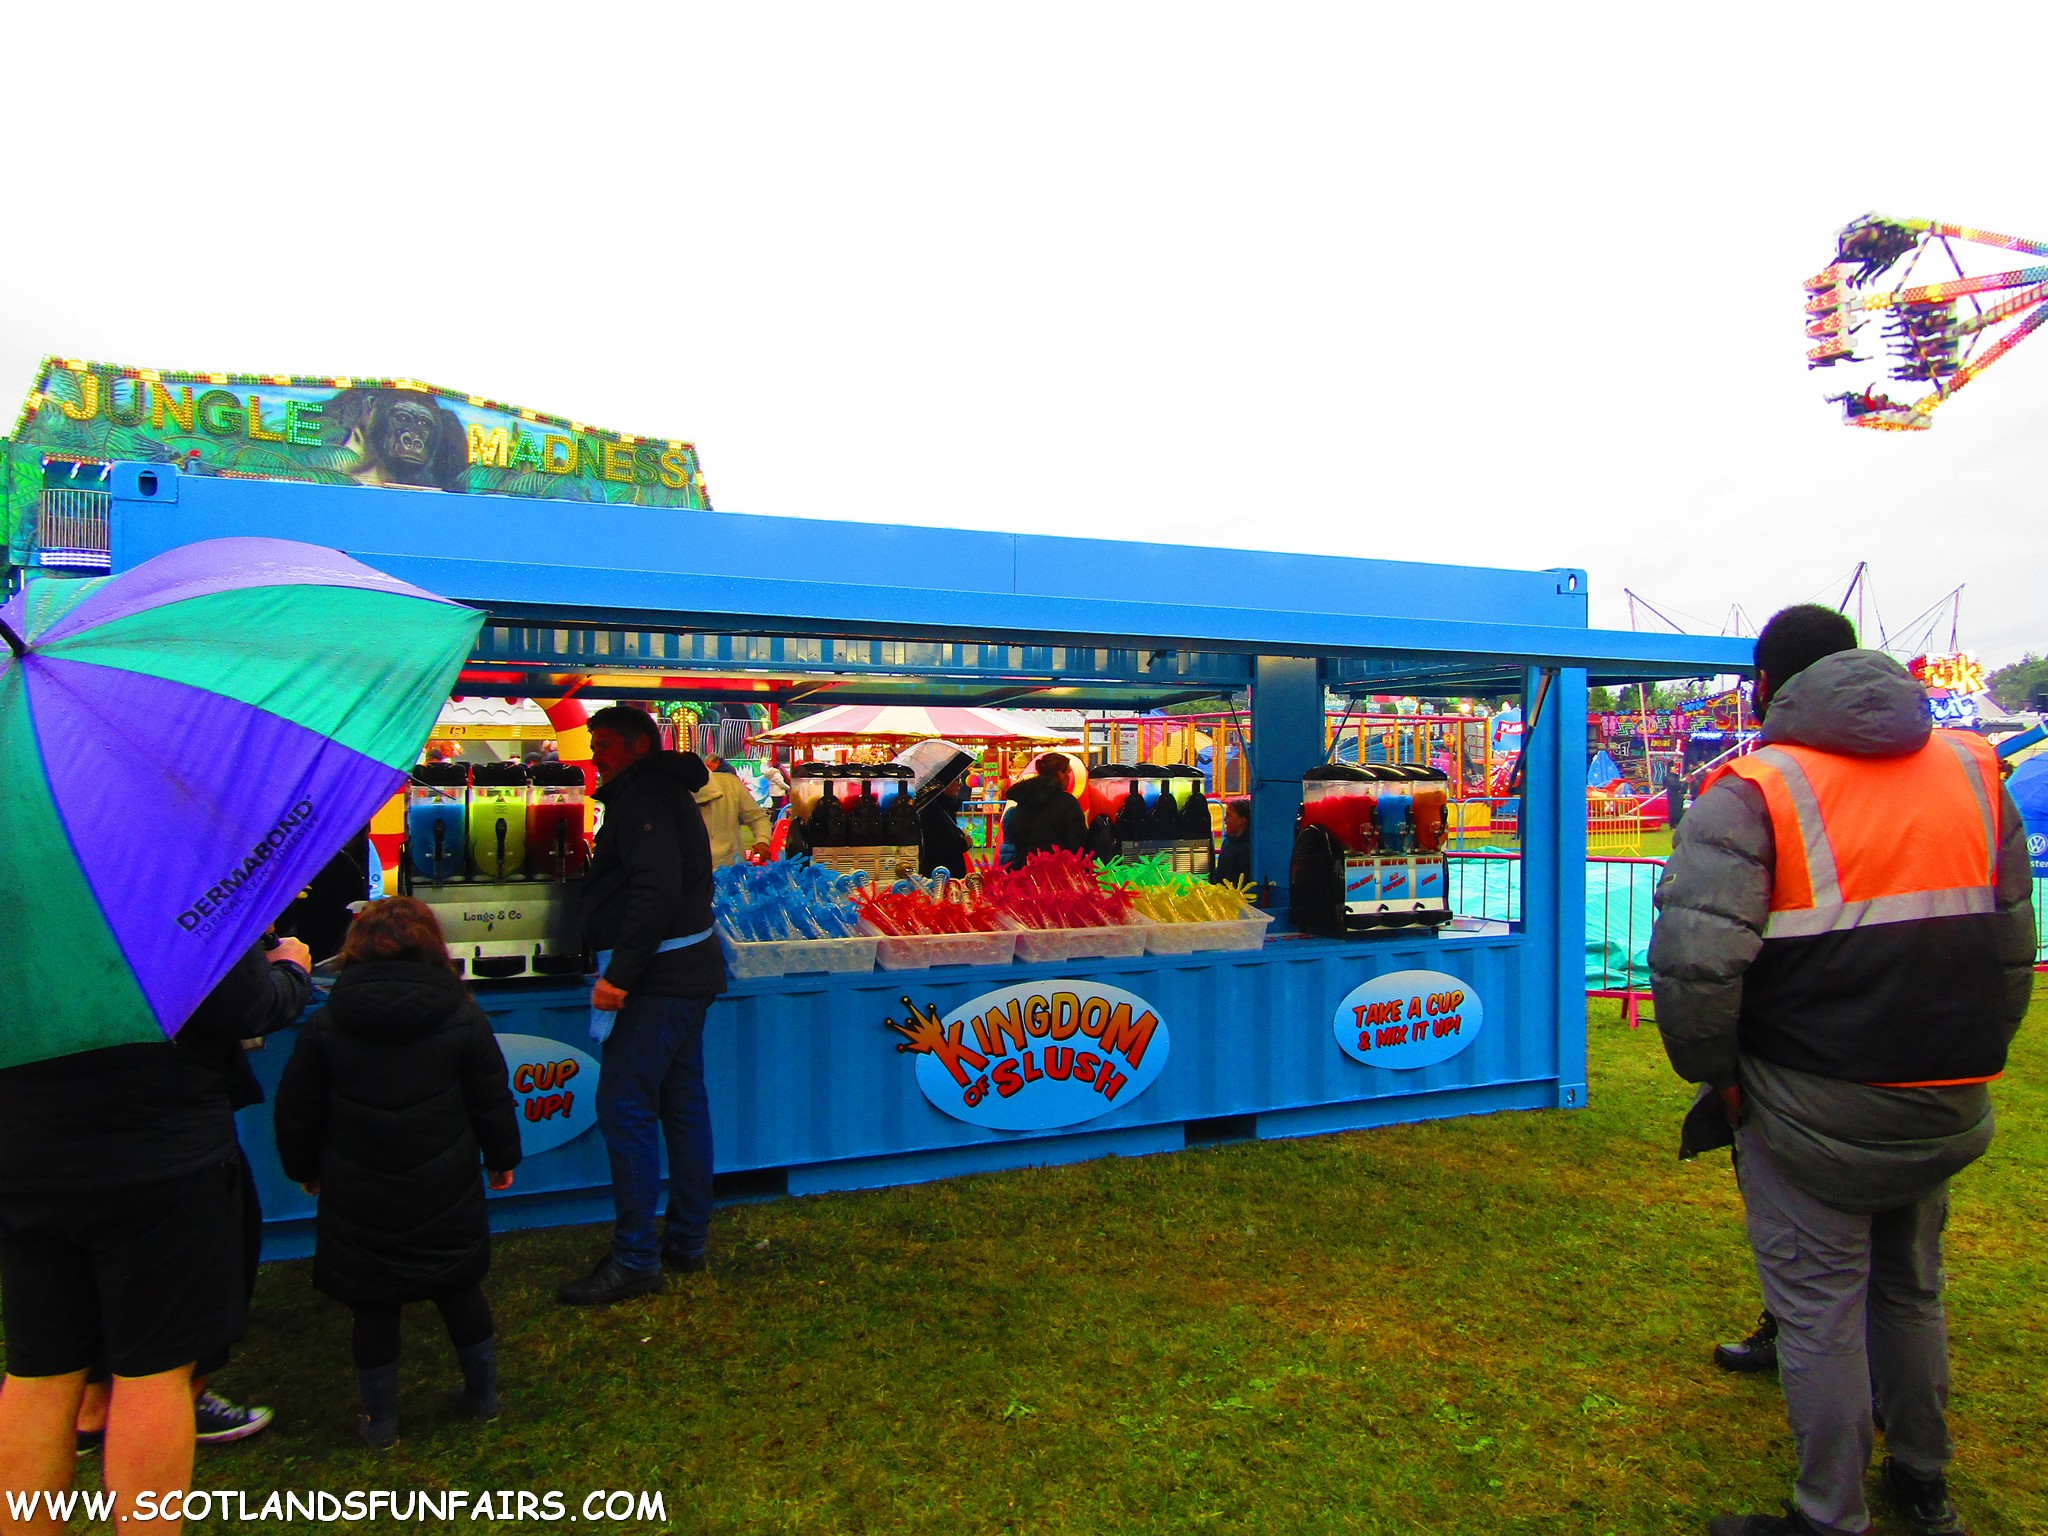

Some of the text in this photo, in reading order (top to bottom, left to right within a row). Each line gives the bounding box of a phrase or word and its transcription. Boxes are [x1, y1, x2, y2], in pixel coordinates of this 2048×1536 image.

[61, 373, 689, 489] JUNGLE MADNESS
[175, 796, 314, 933] DERMABOND
[463, 910, 522, 922] Longo & Co
[1352, 989, 1464, 1028] TAKE A CUP
[922, 992, 1158, 1088] KINGDOM
[1357, 1014, 1462, 1051] & MIX IT UP!
[513, 1058, 579, 1093] CUP
[963, 1046, 1128, 1108] OF SLUSH
[524, 1090, 574, 1122] UP!
